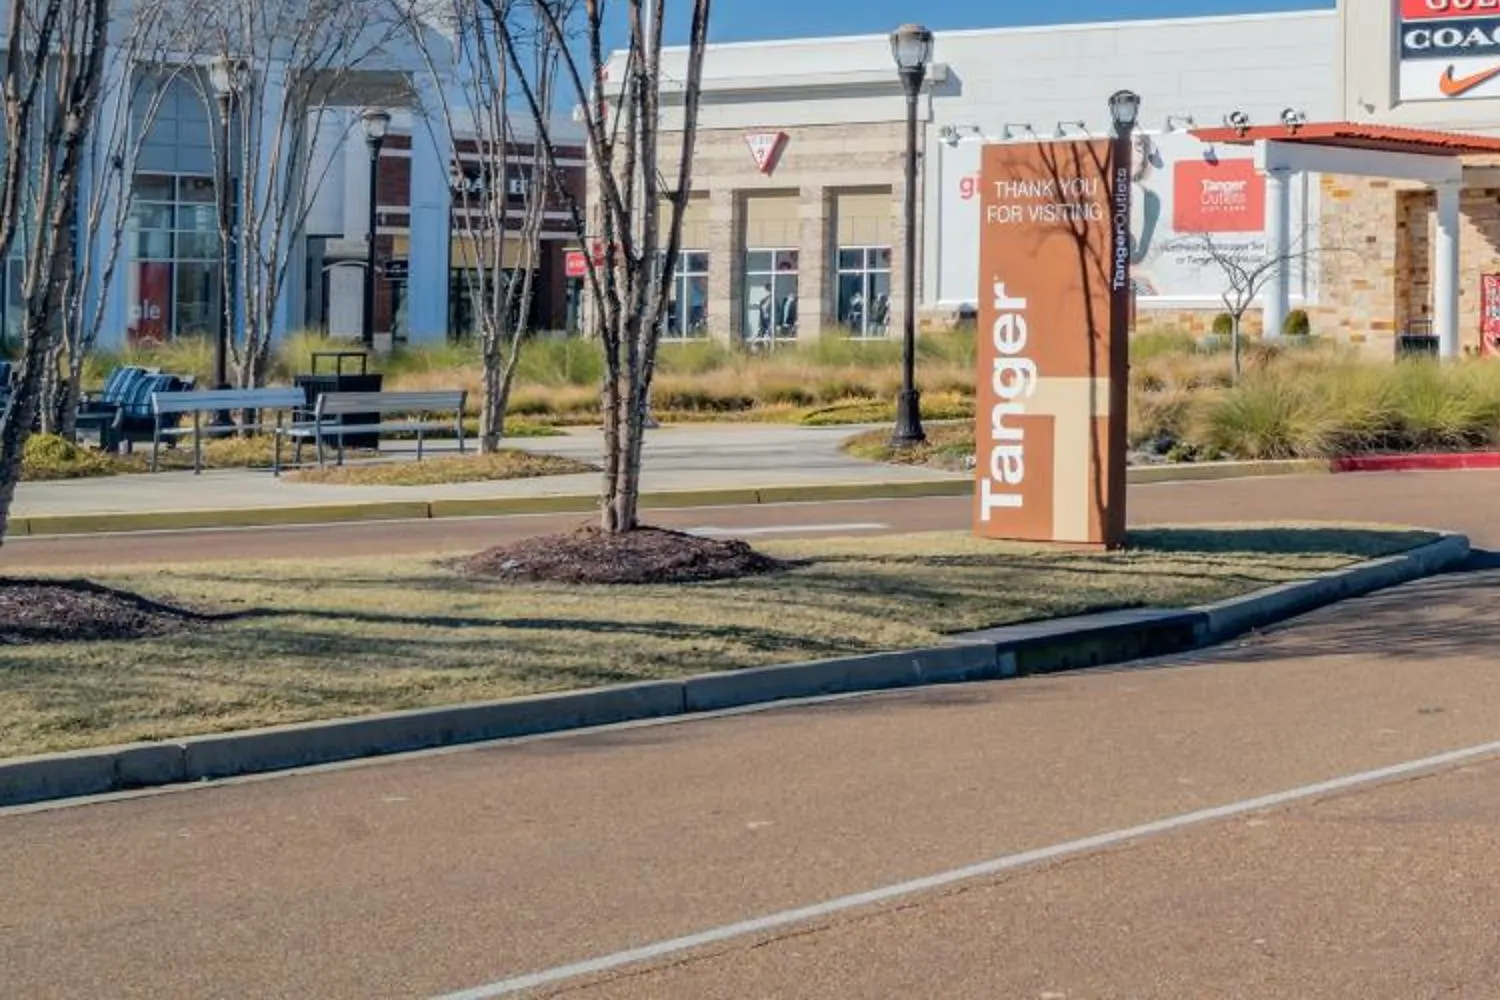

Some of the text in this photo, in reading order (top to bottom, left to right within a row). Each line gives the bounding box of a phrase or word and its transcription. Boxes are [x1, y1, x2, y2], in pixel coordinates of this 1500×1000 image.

[994, 176, 1097, 199] THANK YOU
[987, 200, 1103, 224] FOR VISITING
[981, 279, 1037, 521] Tanger
